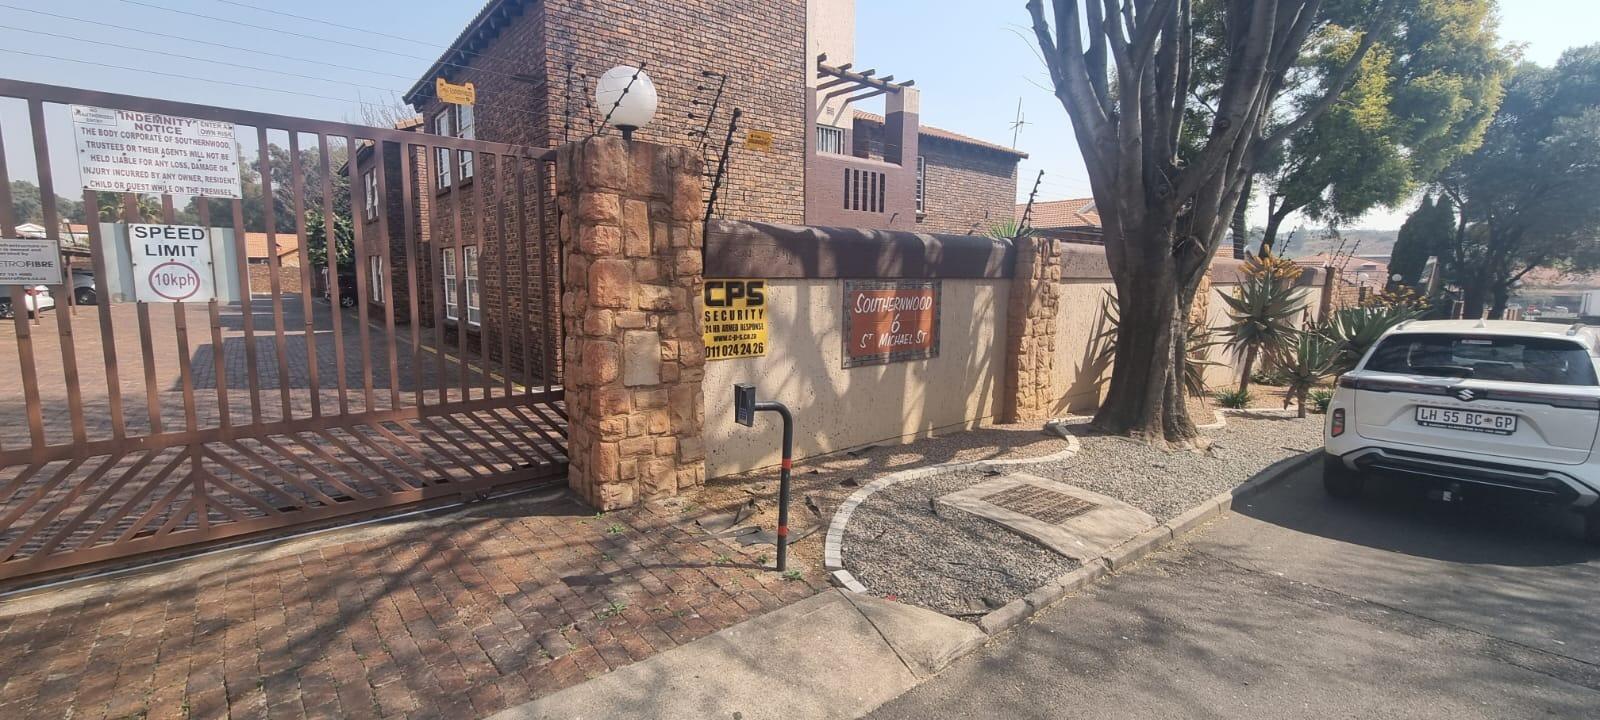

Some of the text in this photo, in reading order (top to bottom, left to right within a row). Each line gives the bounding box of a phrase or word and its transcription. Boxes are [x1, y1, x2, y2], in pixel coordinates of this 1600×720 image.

[120, 112, 192, 127] INDEMNITY
[134, 123, 182, 135] NOTICE
[82, 127, 96, 136] THE
[98, 128, 118, 138] BODY
[120, 131, 162, 142] CORPORATE
[175, 136, 231, 150] SOUTHERNWOOD,
[86, 141, 124, 151] TRUSTEES
[126, 144, 136, 152] OR
[138, 146, 159, 154] THEIR
[161, 147, 188, 156] AGENTS
[190, 150, 204, 158] WILL
[206, 152, 219, 160] NOT
[90, 154, 110, 162] HELD
[112, 156, 136, 164] LIABLE
[171, 162, 190, 170] LOSS,
[192, 163, 218, 172] DAMAGE
[83, 166, 110, 175] INJURY
[113, 168, 149, 178] INCURRED
[178, 174, 204, 184] OWNER,
[90, 180, 112, 188] CHILD
[126, 182, 150, 190] GUEST
[152, 184, 173, 192] WHILE
[134, 226, 205, 240] SPEED
[145, 244, 198, 256] LIMIT
[155, 272, 196, 289] 10kph
[704, 281, 764, 307] CPS
[854, 292, 932, 314] SOUTHERNWOOD
[705, 309, 764, 322] SECURITY
[891, 313, 900, 334] 6
[705, 322, 764, 334] 24 HR ARMED RESPONSE
[878, 332, 912, 350] MICHAEL
[916, 330, 928, 344] ST
[705, 342, 764, 358] 011 024 24 26
[1421, 408, 1512, 428] LH 55 BC GP
